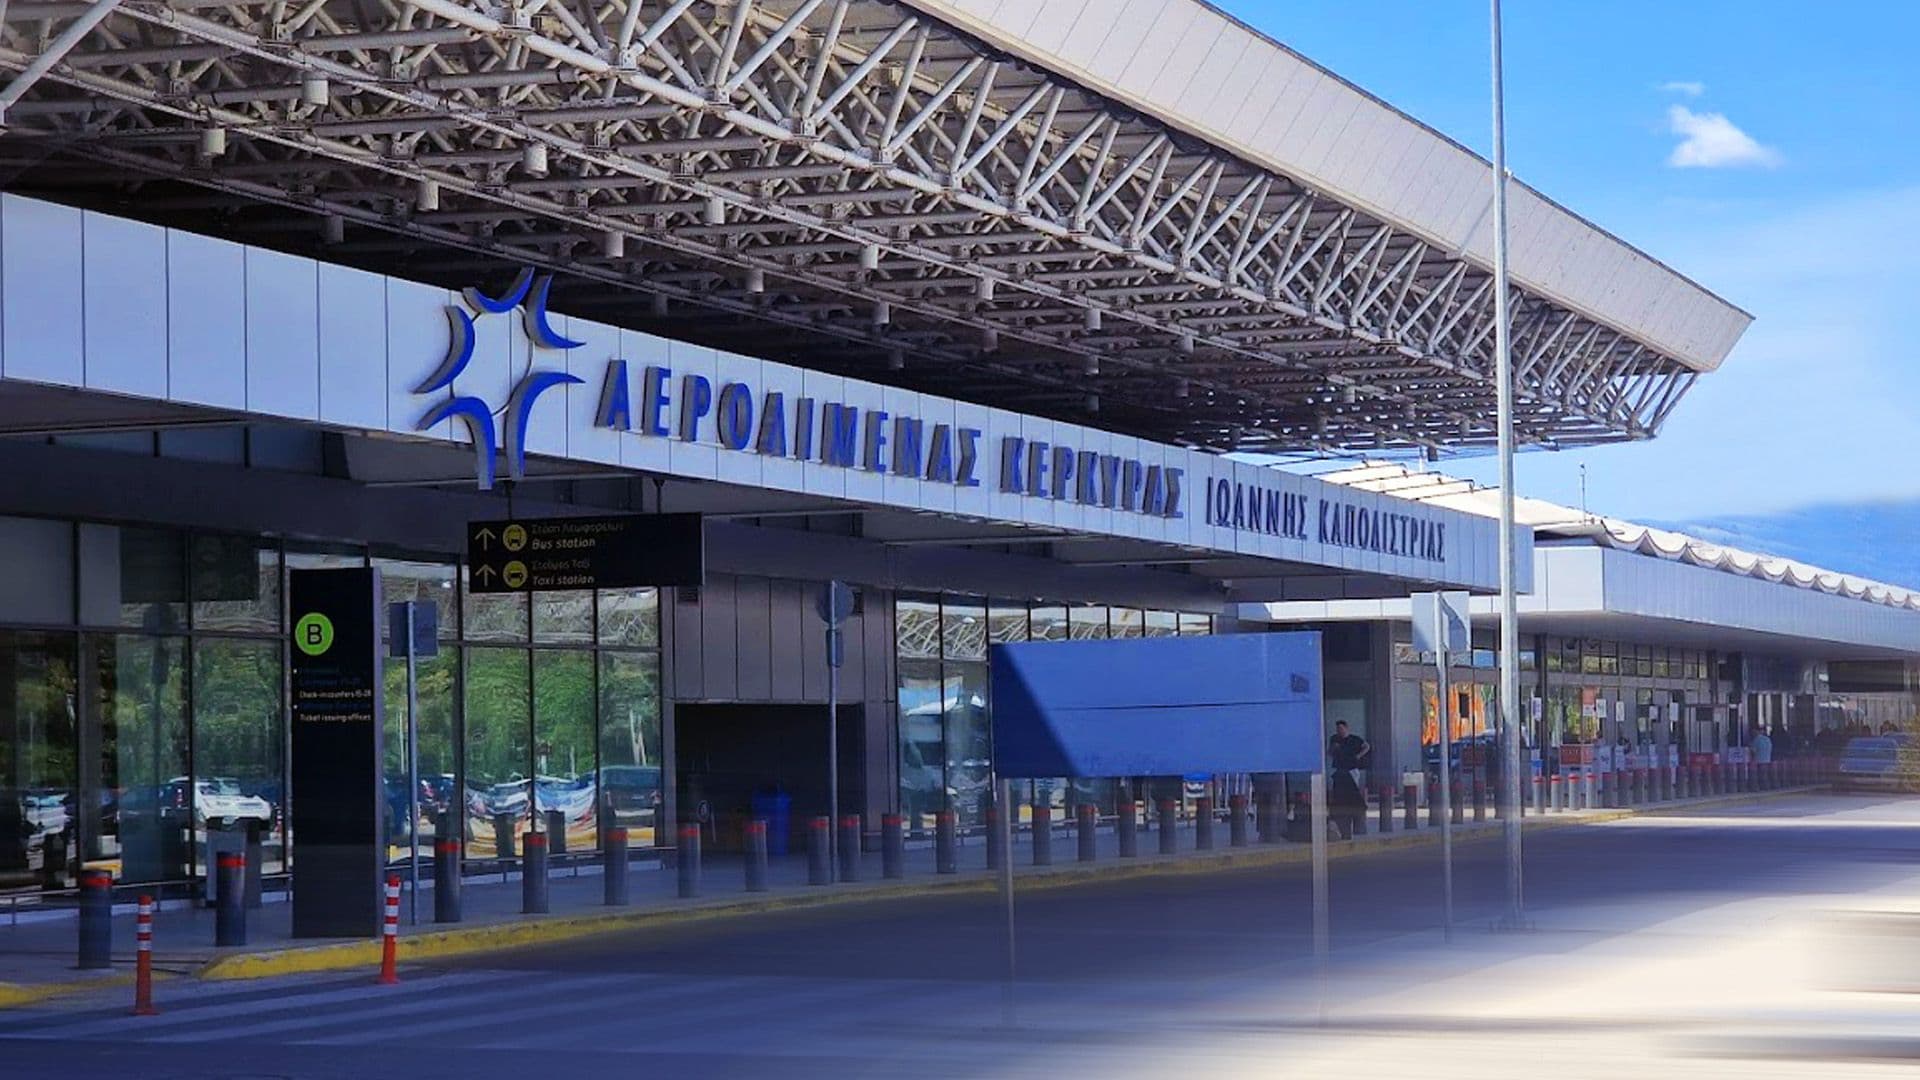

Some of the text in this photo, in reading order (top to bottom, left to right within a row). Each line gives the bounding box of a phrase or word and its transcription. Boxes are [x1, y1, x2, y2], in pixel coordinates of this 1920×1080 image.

[594, 360, 1446, 562] ΑΕΡΟΛΙΜΕΝΑΣ ΚΕΡΚΥΡΑΣ ΙΩΑΝΝΗΣ ΚΑΠΟΔΙΣΤΡΙΑΣ
[531, 537, 596, 550] Bus station
[532, 573, 595, 586] Taxi station
[307, 624, 323, 645] B
